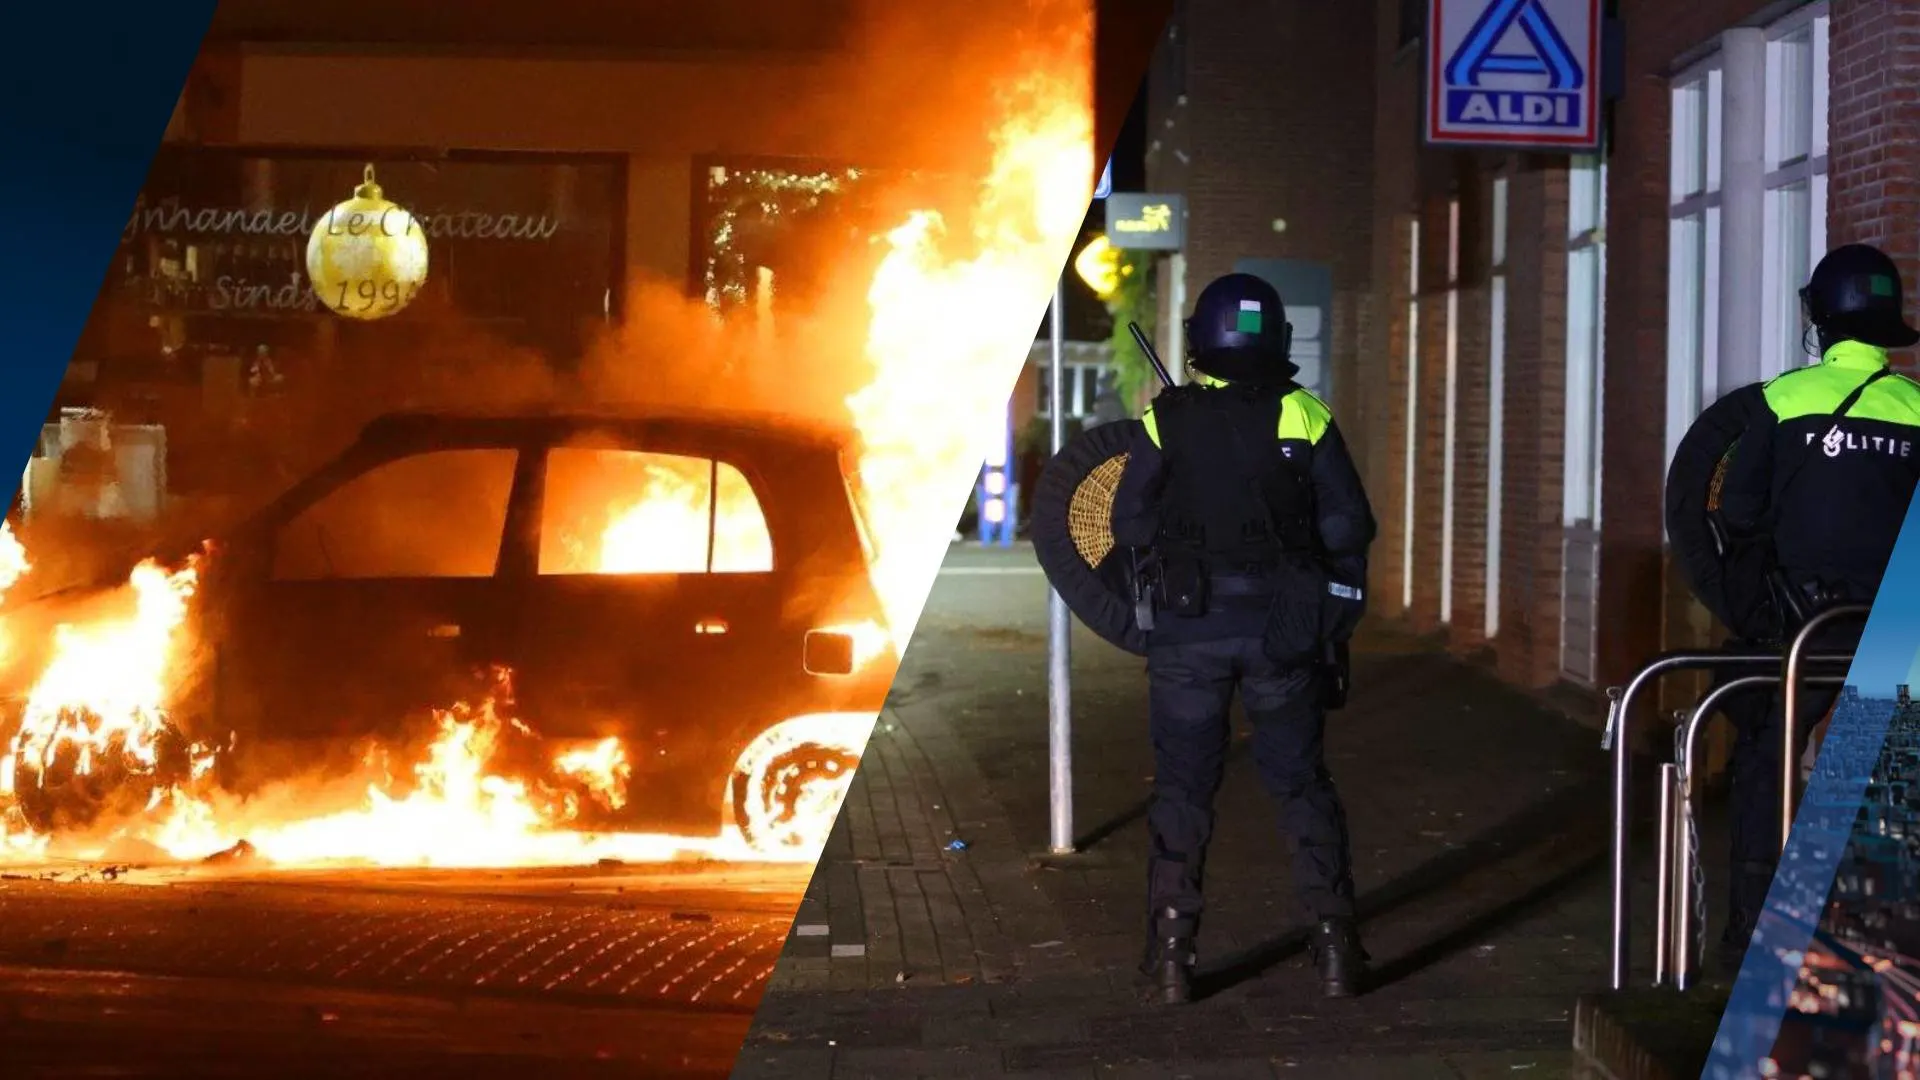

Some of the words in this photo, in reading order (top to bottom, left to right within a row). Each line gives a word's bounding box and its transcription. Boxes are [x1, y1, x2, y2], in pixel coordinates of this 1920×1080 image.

[1460, 93, 1569, 124] ALDI
[327, 204, 373, 236] Le
[208, 272, 322, 311] Sinds
